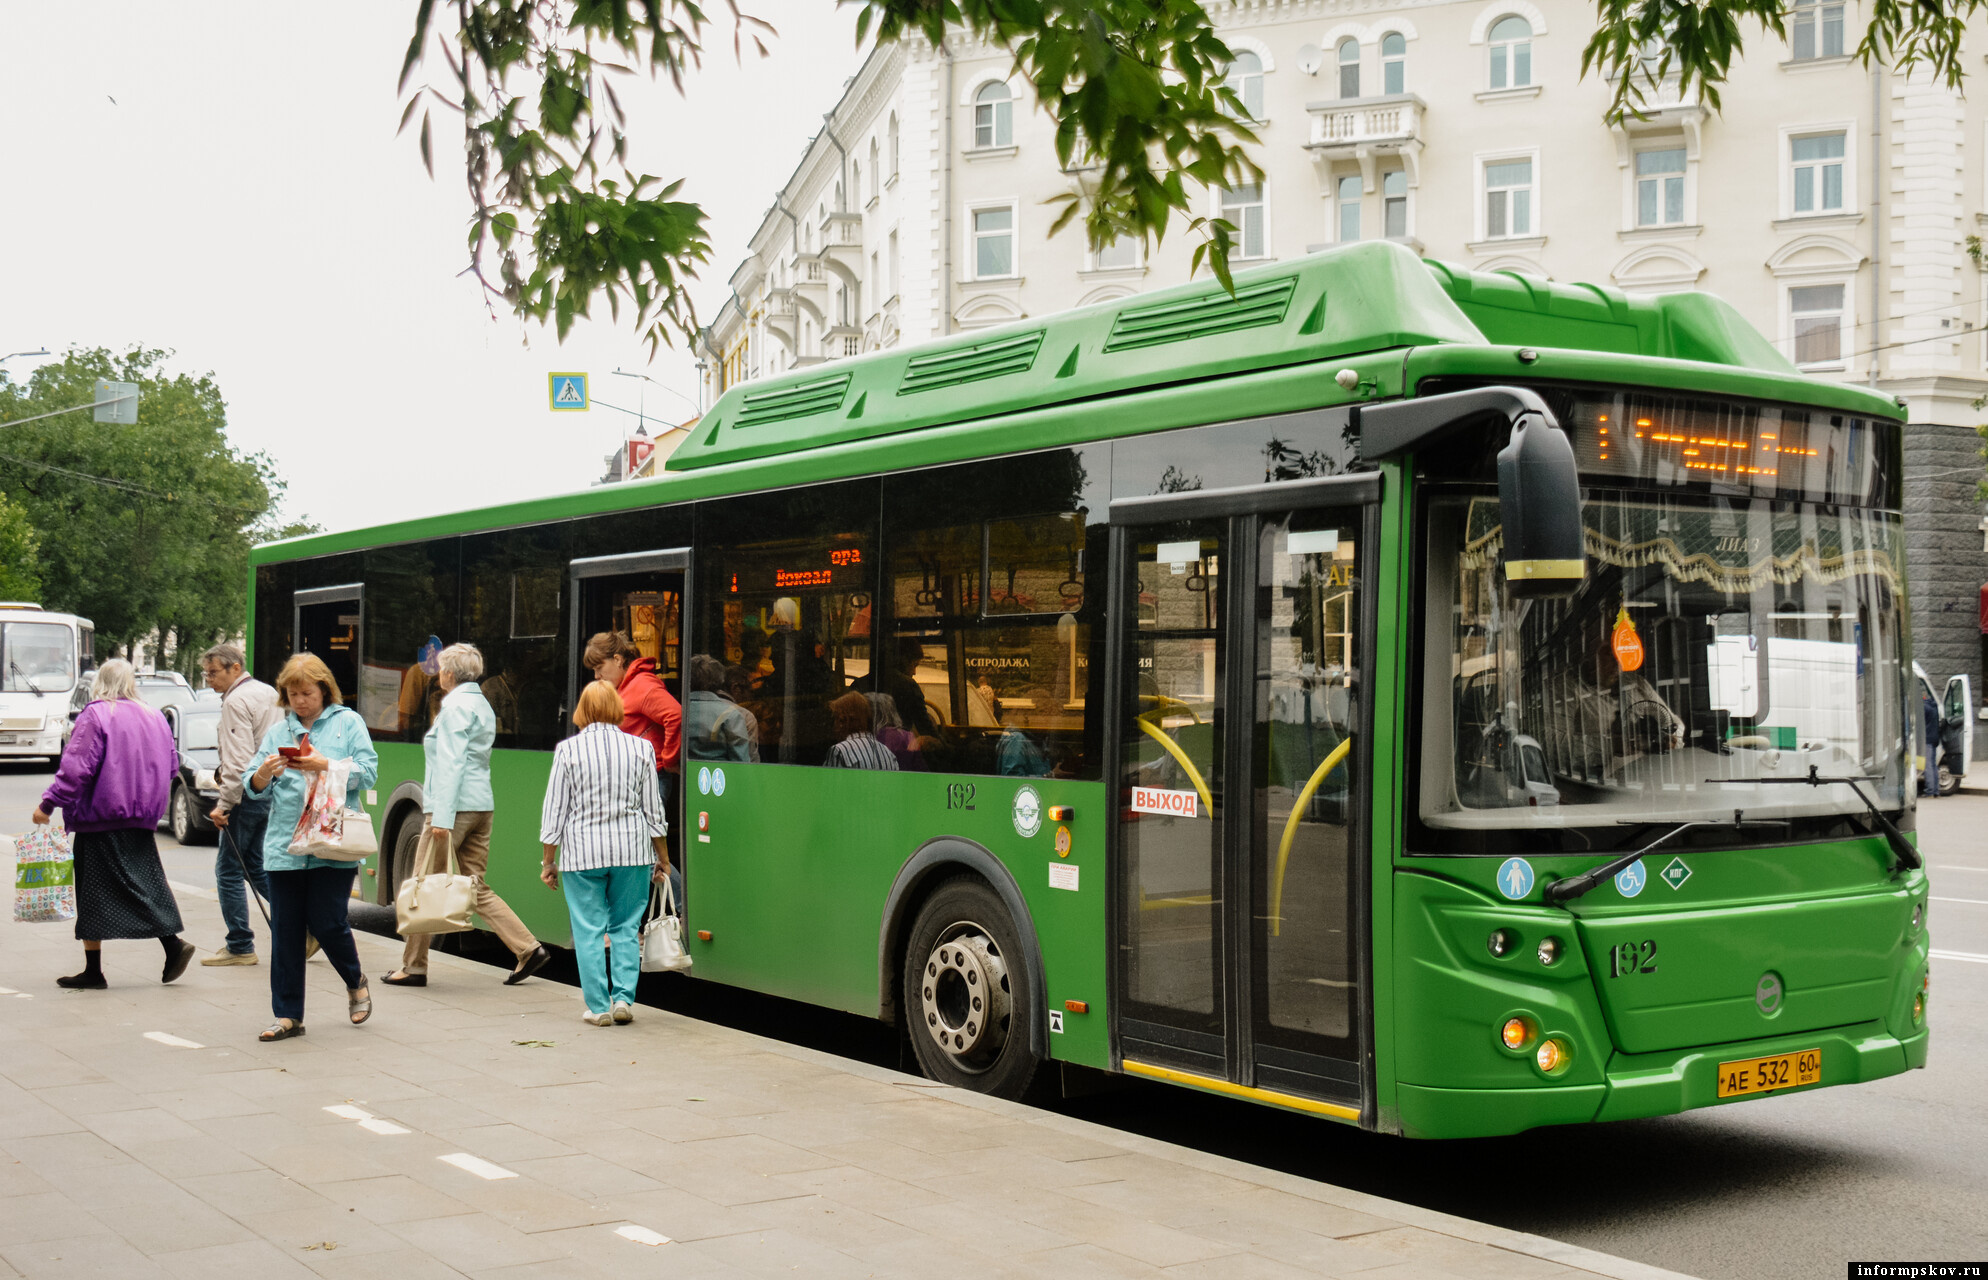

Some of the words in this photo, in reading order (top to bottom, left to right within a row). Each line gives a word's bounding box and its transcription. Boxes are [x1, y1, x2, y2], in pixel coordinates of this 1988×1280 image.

[1716, 537, 1760, 551] ЛИАЗ
[965, 658, 1030, 668] АСПРОДАЖА
[947, 783, 976, 810] 192
[1136, 791, 1195, 816] ВЫХОД
[1669, 868, 1683, 878] КПГ
[1609, 939, 1657, 979] 192
[1757, 1059, 1789, 1087] 532
[1799, 1053, 1815, 1073] 60
[1800, 1073, 1813, 1083] RUS
